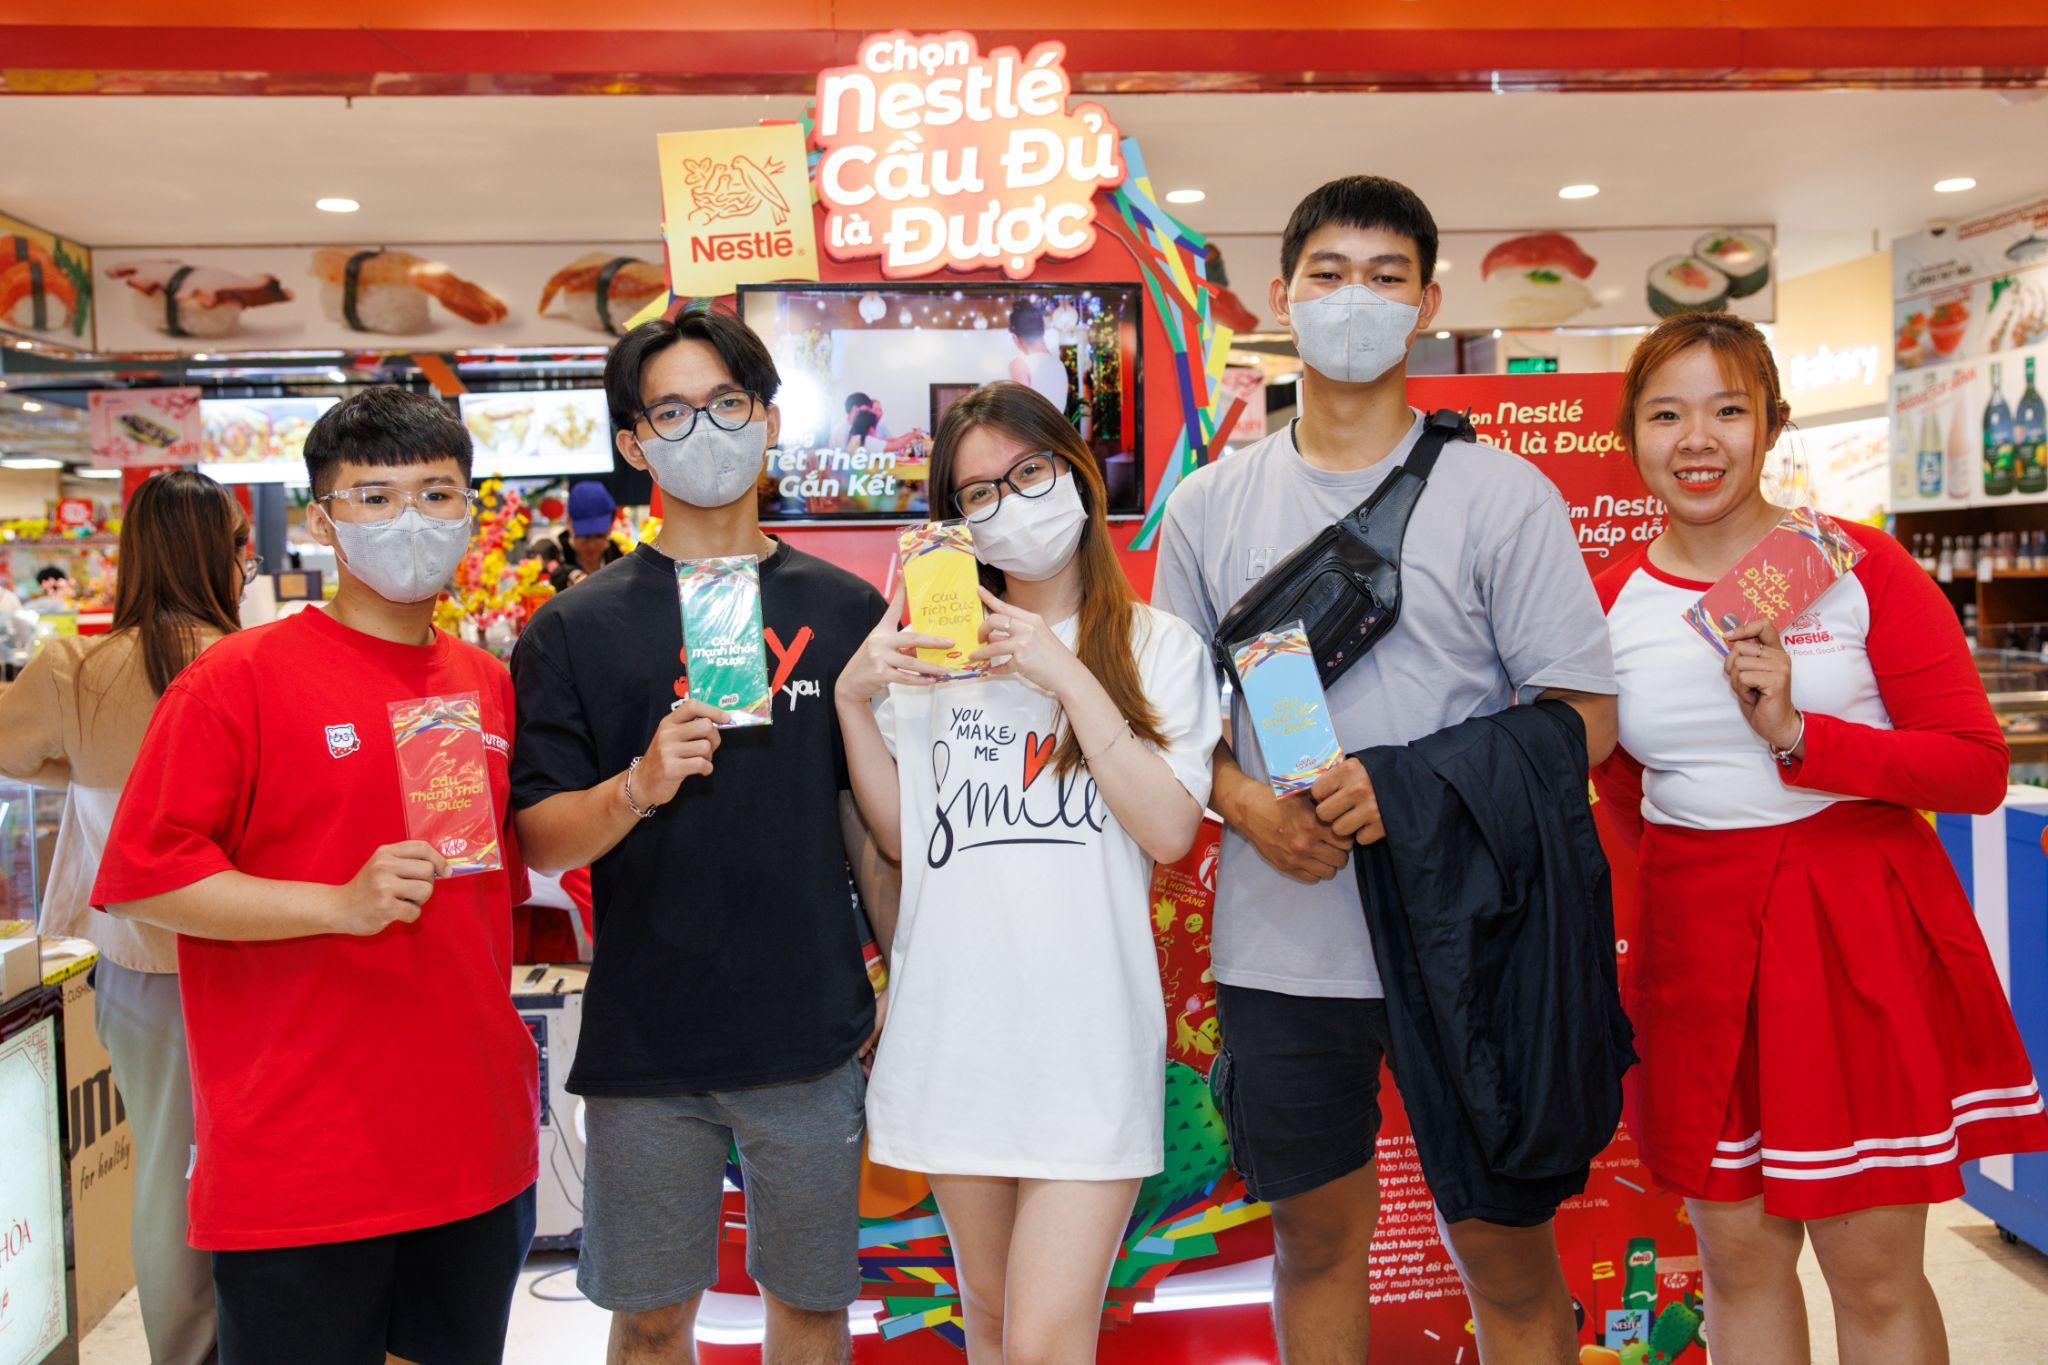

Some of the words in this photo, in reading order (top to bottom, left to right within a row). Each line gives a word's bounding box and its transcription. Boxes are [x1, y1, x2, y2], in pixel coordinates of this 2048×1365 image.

[865, 39, 969, 76] Chọn
[822, 134, 984, 206] Cầu
[1001, 112, 1119, 189] Đủ
[690, 229, 794, 264] Nestlé
[831, 213, 872, 248] là
[883, 197, 1089, 270] Được
[1520, 431, 1548, 454] là
[765, 446, 807, 471] Tết
[815, 447, 896, 471] Thêm
[847, 470, 896, 497] Kết
[781, 679, 820, 712] you
[950, 707, 984, 731] YOU
[956, 724, 1016, 746] MAKE
[974, 745, 1000, 762] ME
[79, 1164, 95, 1201] for
[97, 1134, 132, 1181] healthy
